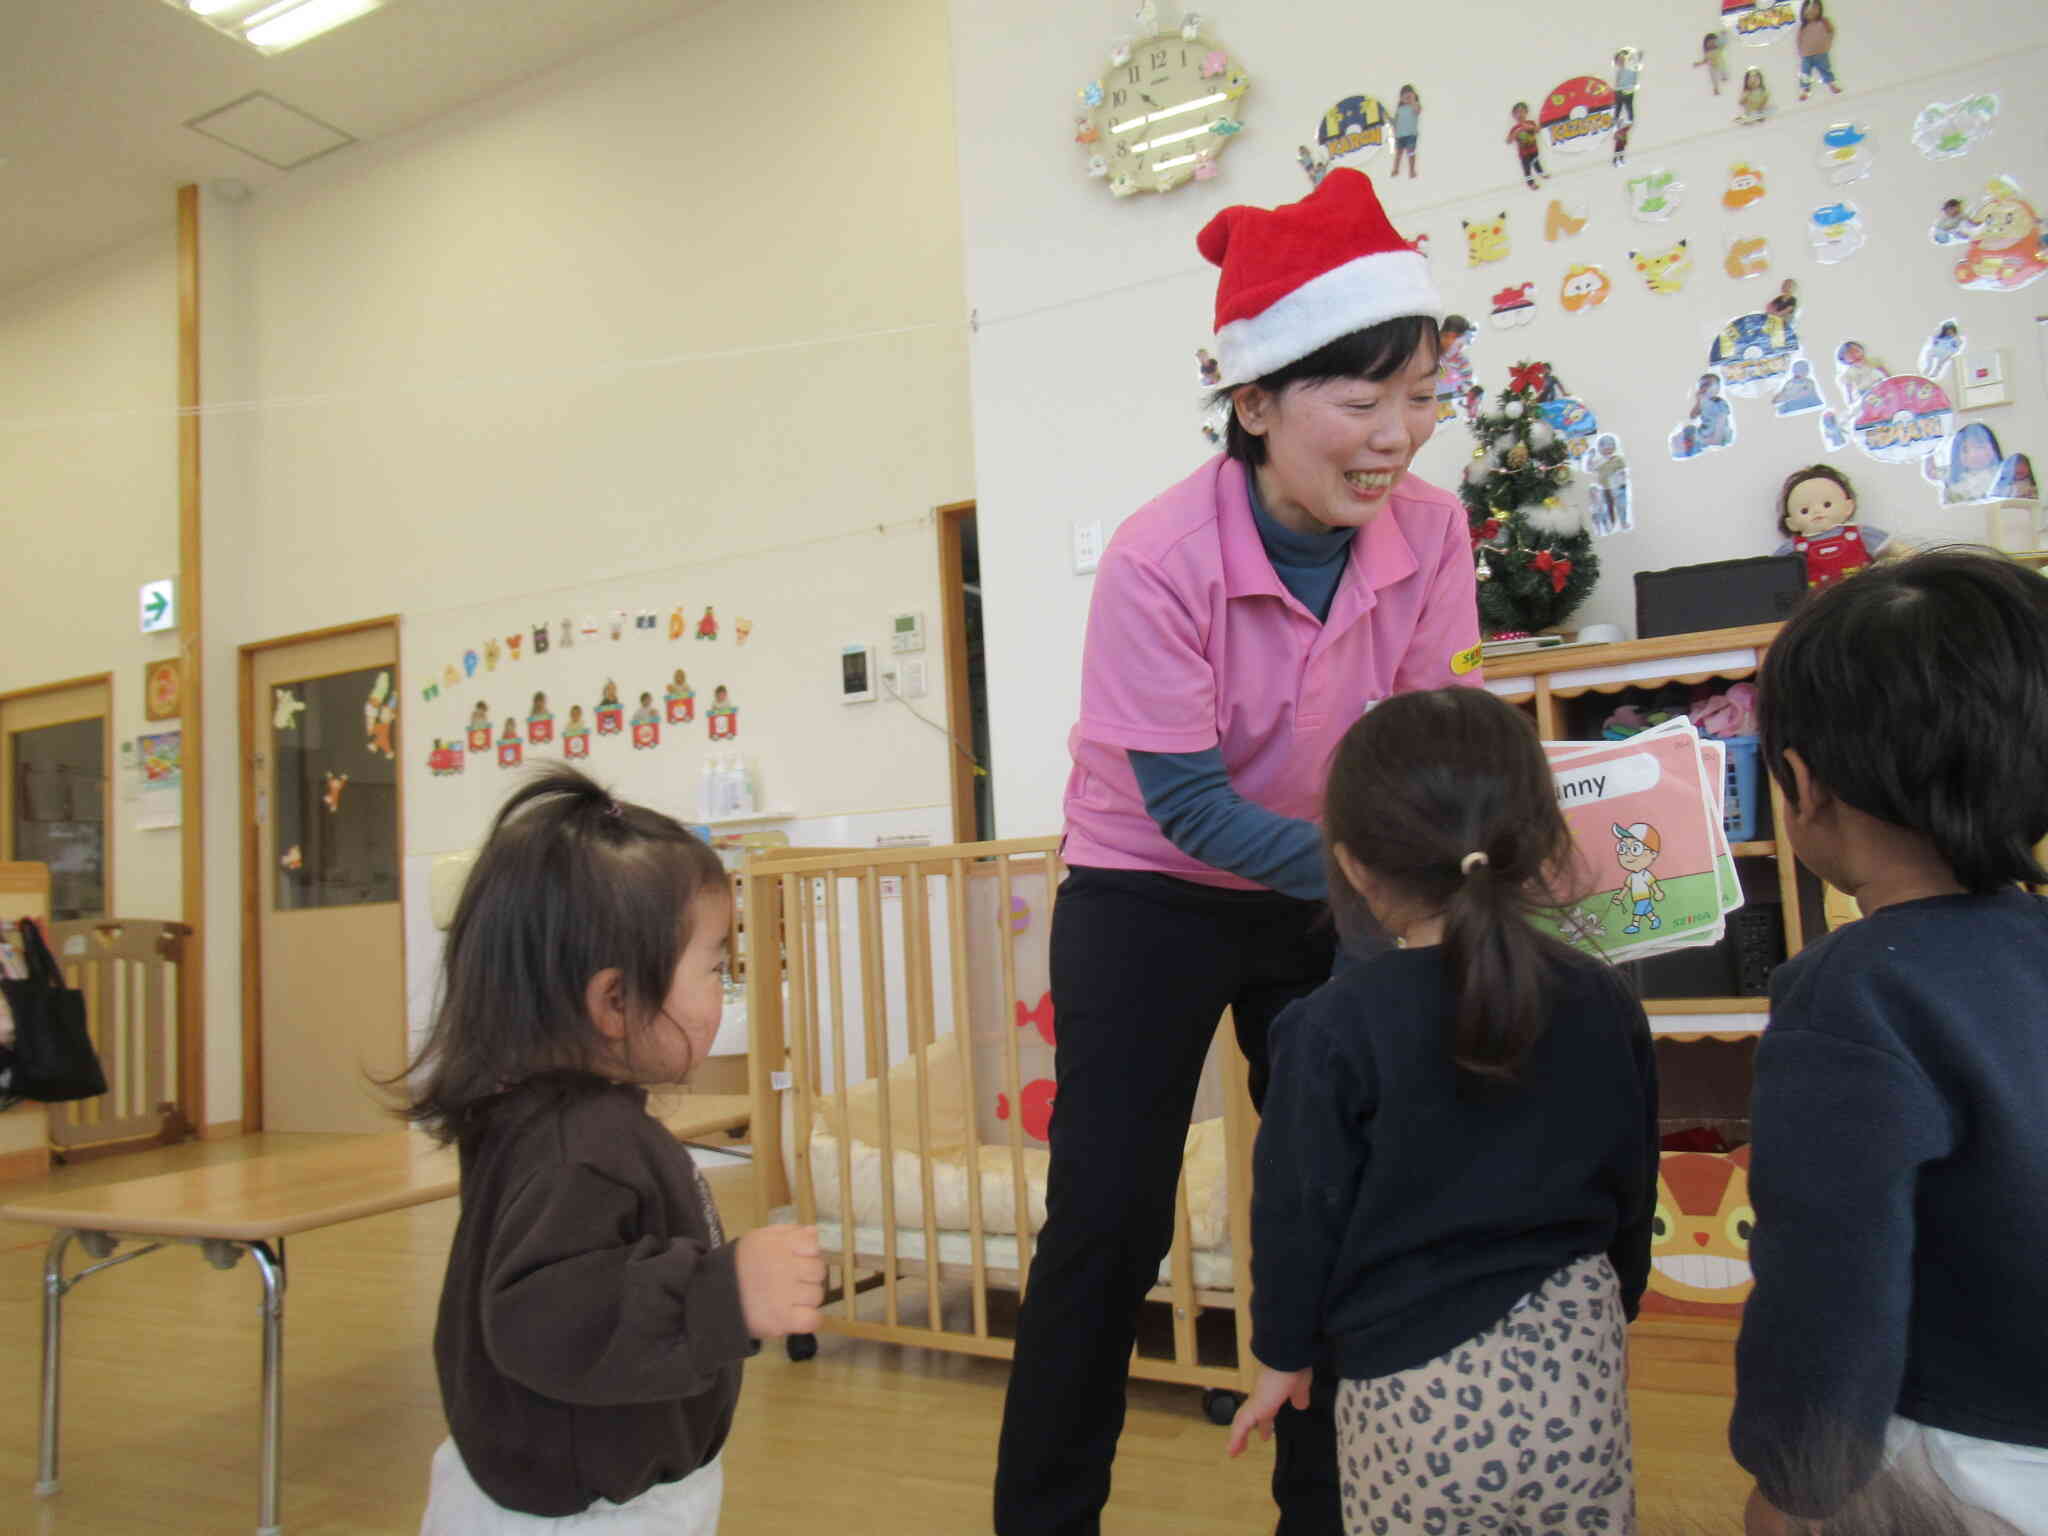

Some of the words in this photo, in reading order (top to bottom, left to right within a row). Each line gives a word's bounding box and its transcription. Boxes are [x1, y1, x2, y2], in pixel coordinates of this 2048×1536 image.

[1149, 49, 1168, 71] 12
[1180, 49, 1187, 68] 1
[1127, 66, 1141, 85] 11
[1111, 88, 1127, 108] 10
[1116, 141, 1127, 158] 8
